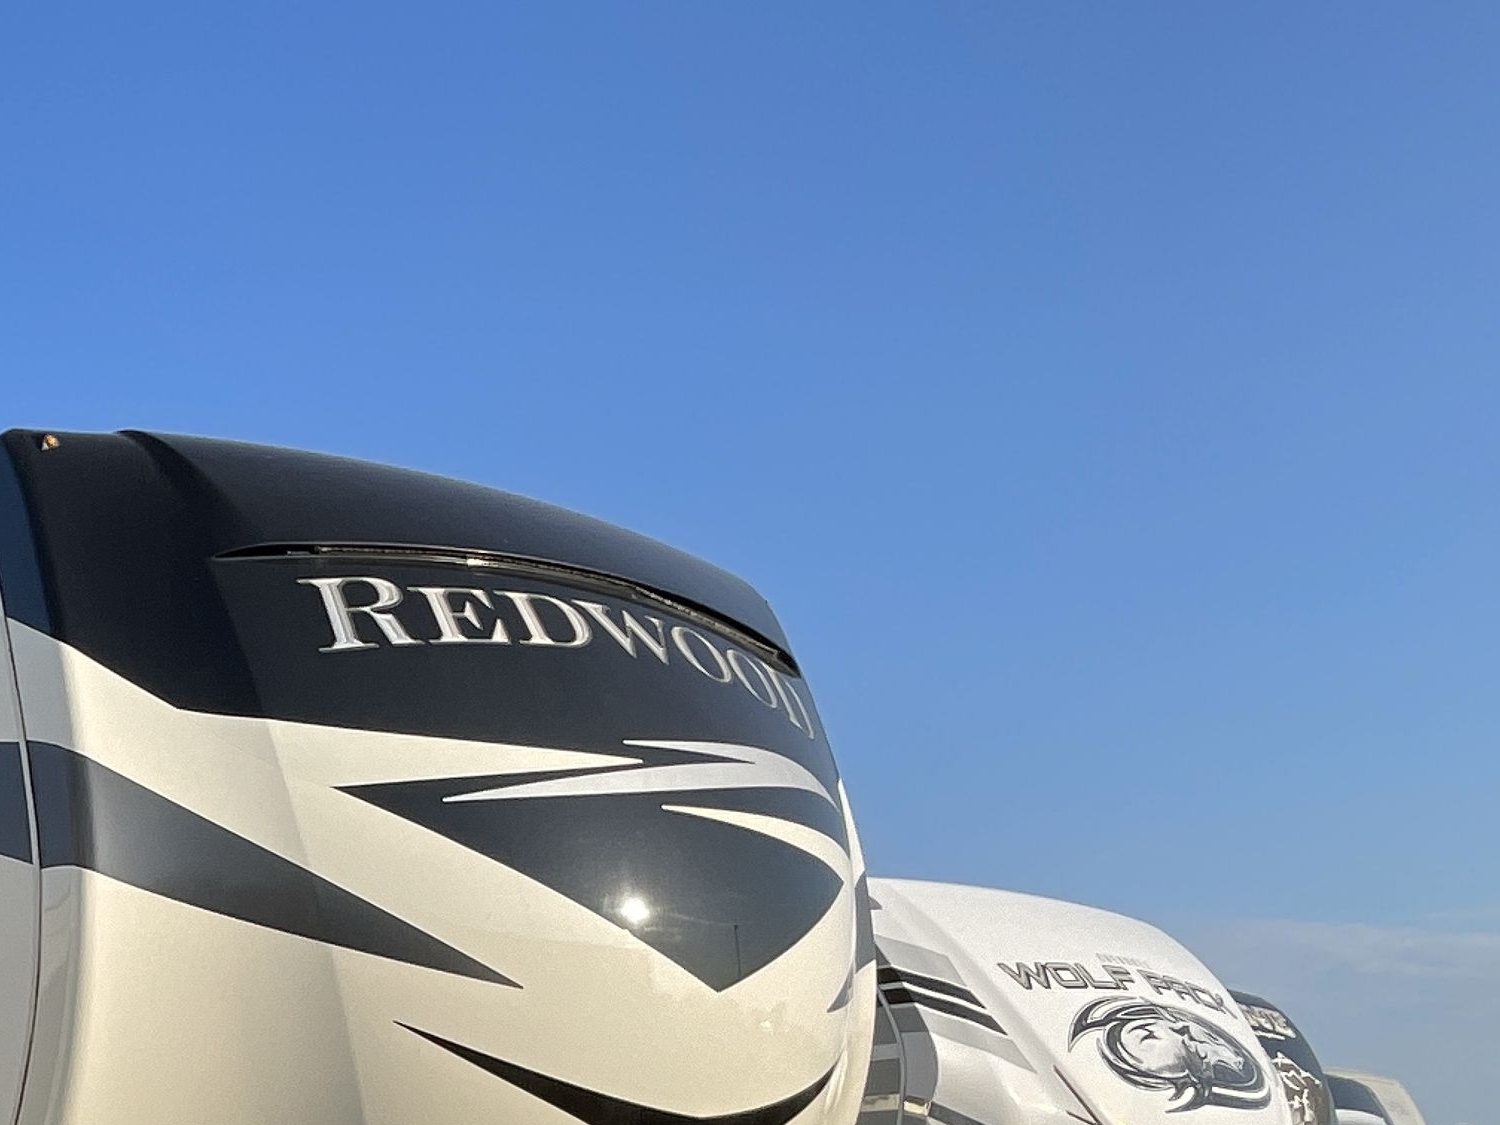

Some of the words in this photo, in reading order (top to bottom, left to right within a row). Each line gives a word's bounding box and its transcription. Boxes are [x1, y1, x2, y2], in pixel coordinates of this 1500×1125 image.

[297, 575, 816, 740] REDWOOD
[997, 961, 1136, 990] WOLF
[1136, 968, 1238, 1020] PACK
